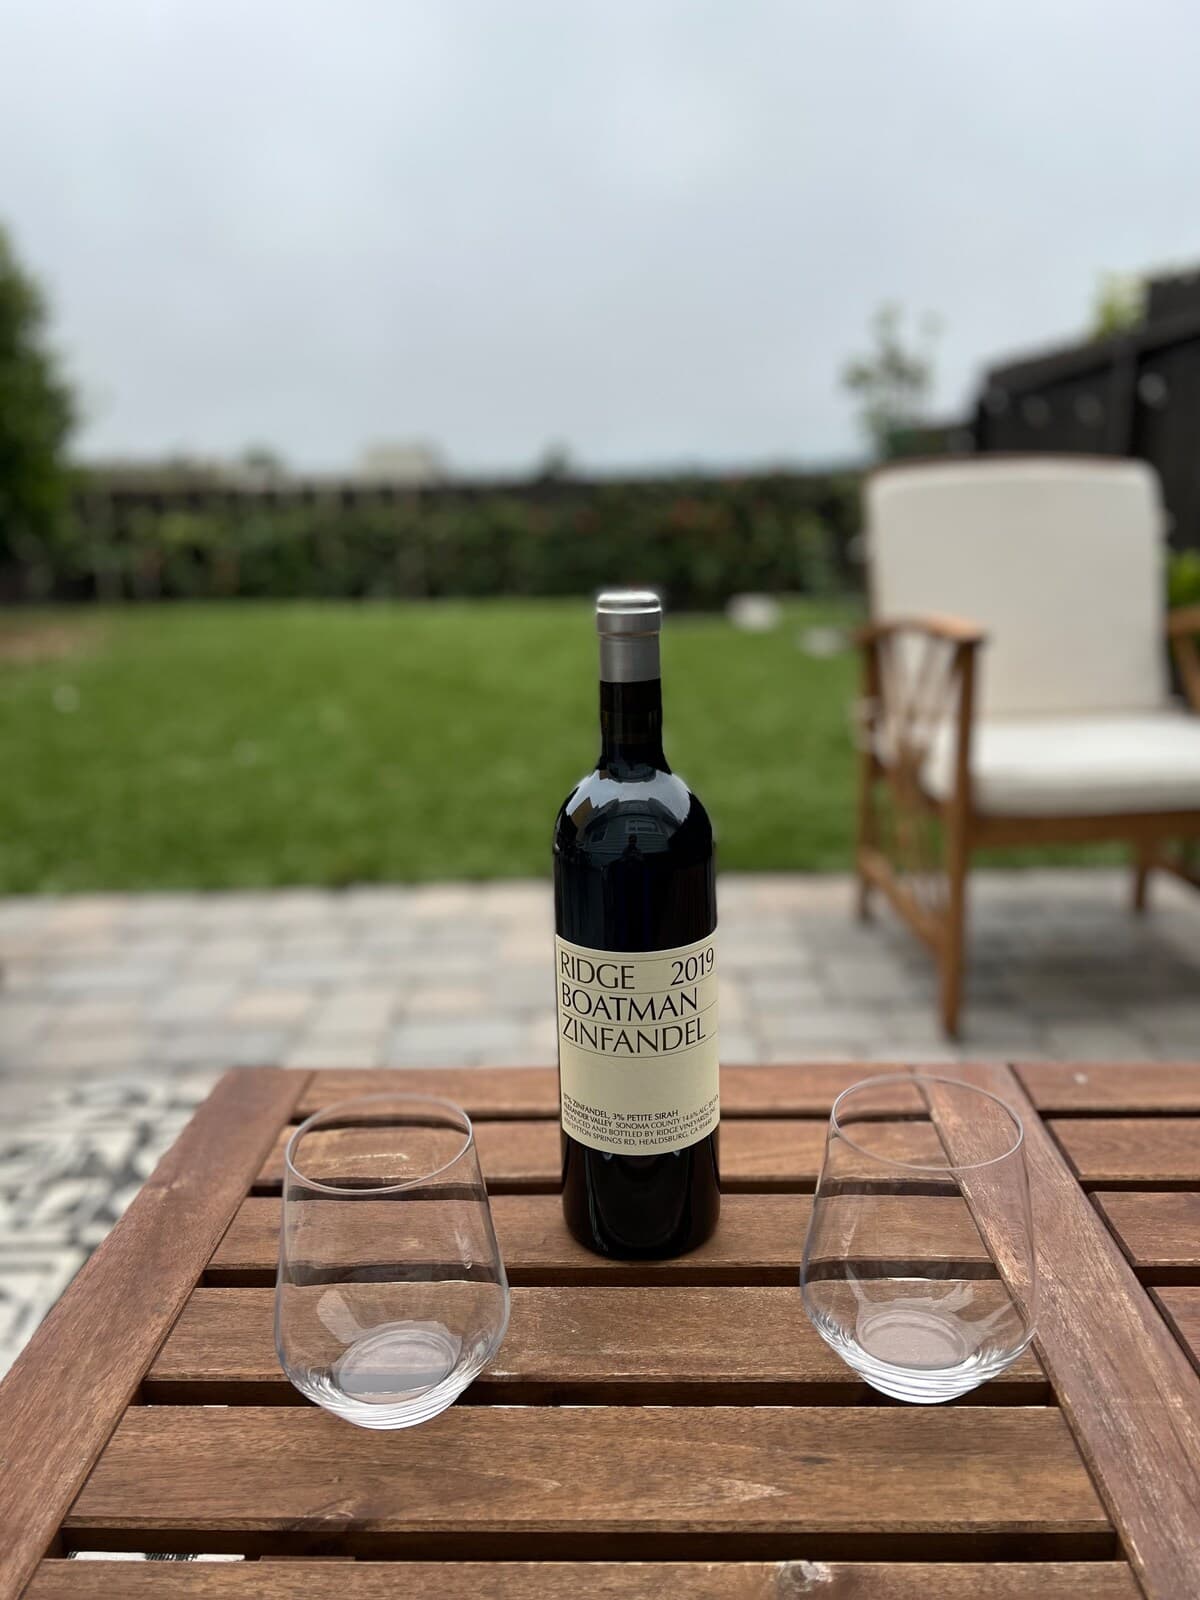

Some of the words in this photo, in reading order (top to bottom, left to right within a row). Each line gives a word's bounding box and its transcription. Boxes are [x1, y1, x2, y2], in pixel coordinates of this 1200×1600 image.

[561, 951, 635, 989] RIDGE
[670, 947, 714, 986] 2019
[562, 982, 697, 1022] BOATMAN
[562, 1013, 706, 1053] ZINFANDEL
[589, 1115, 613, 1127] VALLEY
[615, 1121, 649, 1130] SONOMA
[651, 1117, 680, 1129] COUNTY
[612, 1112, 625, 1121] 3%
[627, 1113, 653, 1122] PETITE
[654, 1109, 678, 1121] SIRAH
[592, 1124, 607, 1134] AND
[609, 1128, 643, 1138] BOTTLED
[644, 1130, 655, 1138] BY
[656, 1126, 678, 1137] RIDGE
[592, 1132, 622, 1145] SPRINGS
